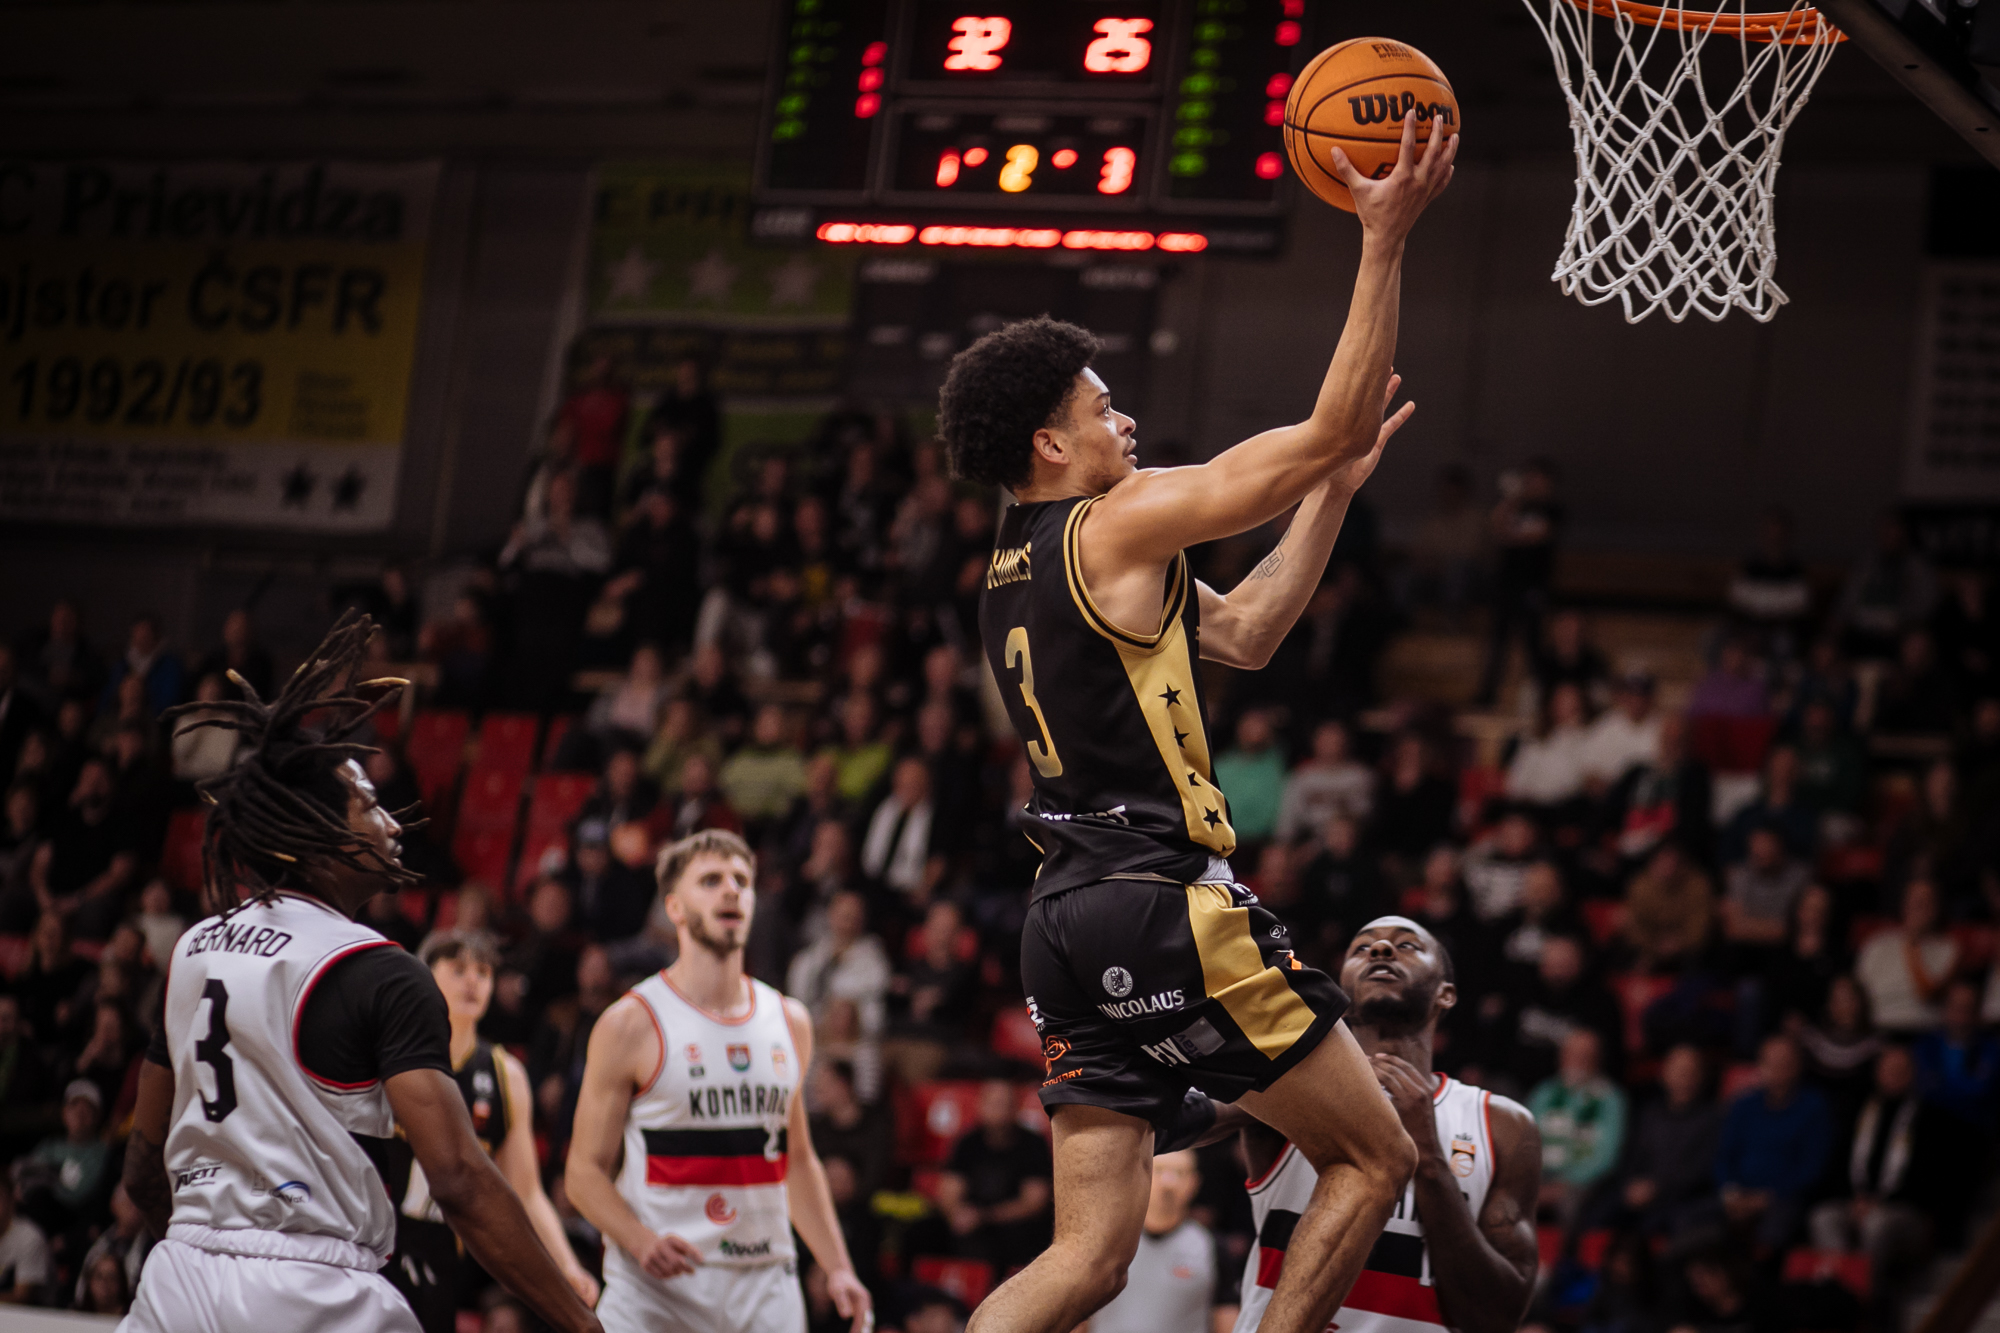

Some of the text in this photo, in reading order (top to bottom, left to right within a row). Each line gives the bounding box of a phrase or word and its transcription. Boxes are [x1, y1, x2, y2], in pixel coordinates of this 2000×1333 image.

[1348, 91, 1455, 126] Wilson
[60, 165, 403, 238] Prievidza
[188, 250, 386, 335] ČSFR
[12, 355, 263, 429] 1992/93
[1004, 626, 1063, 778] 3
[186, 922, 293, 958] BERNARD
[1101, 989, 1186, 1020] NICOLAUS
[196, 978, 238, 1123] 3
